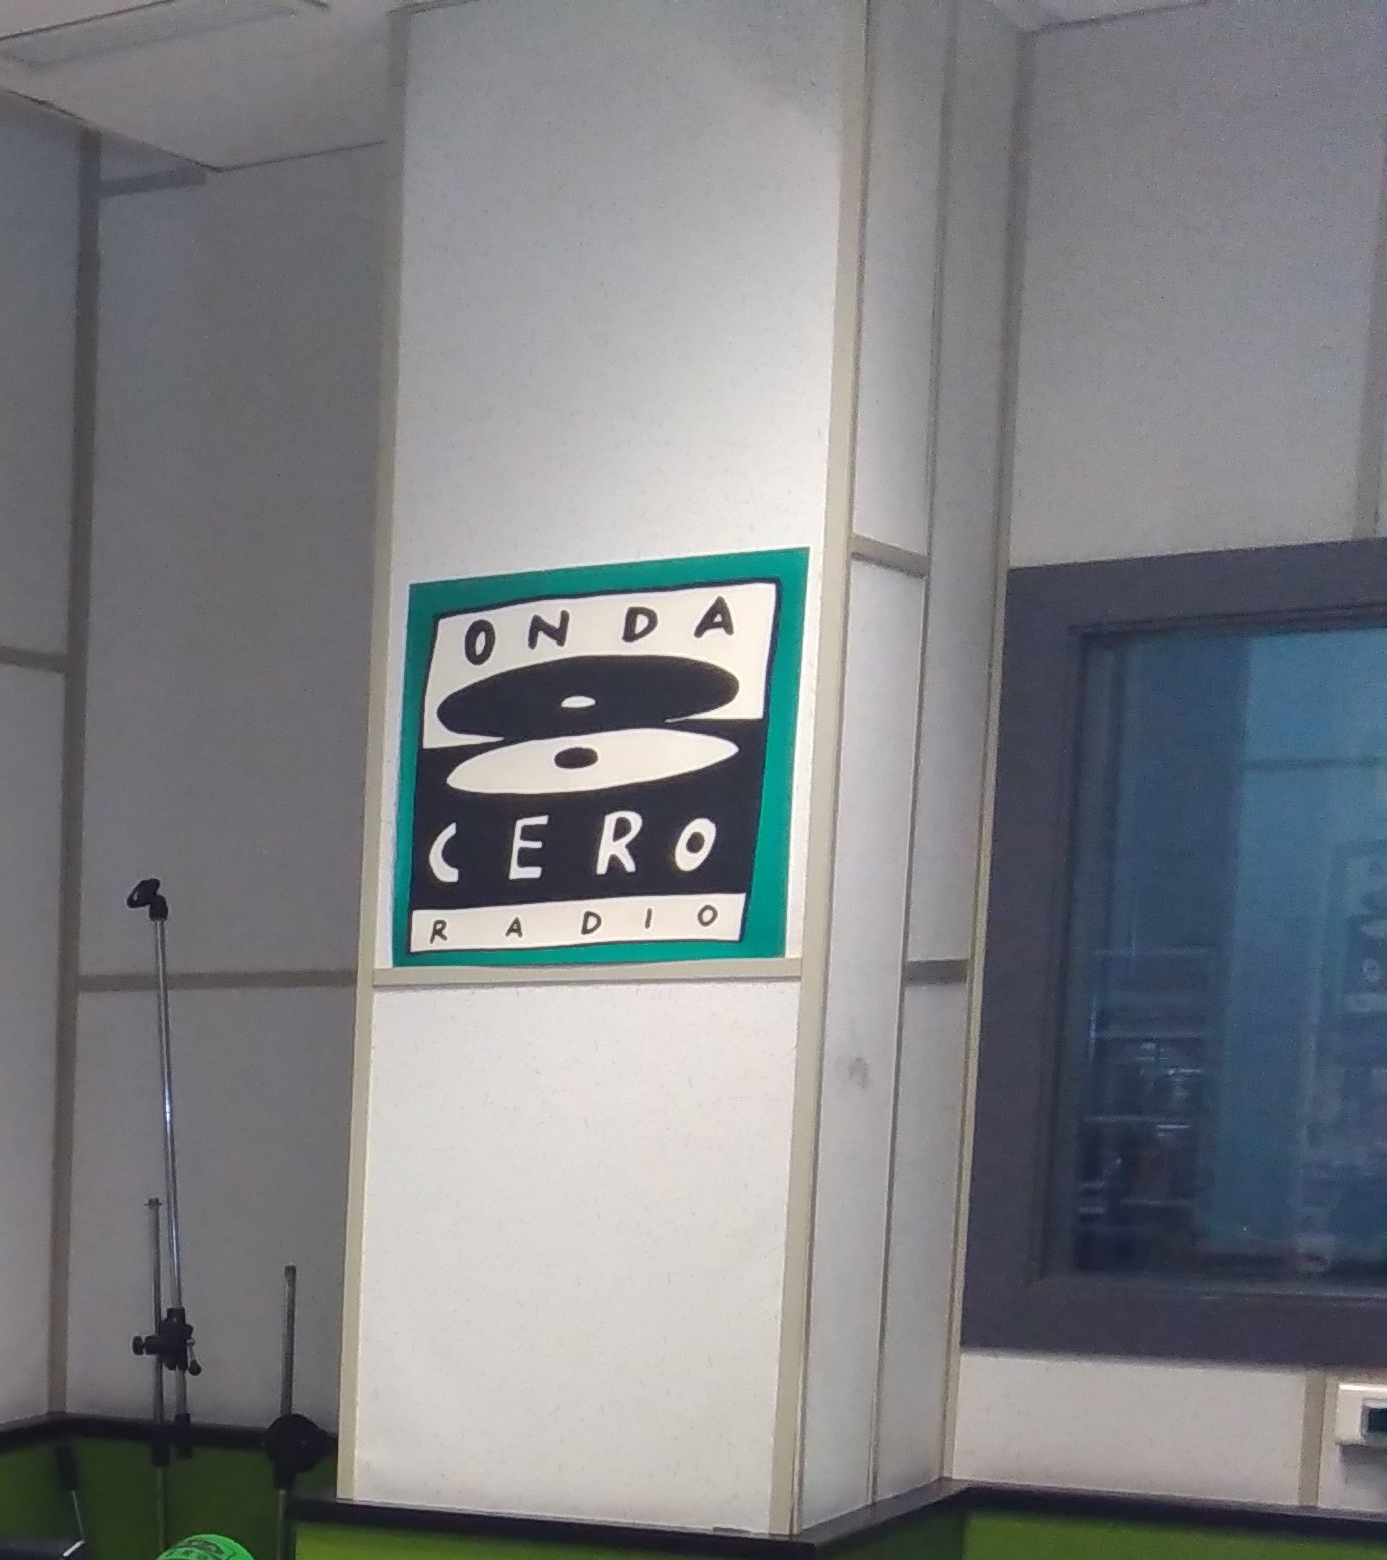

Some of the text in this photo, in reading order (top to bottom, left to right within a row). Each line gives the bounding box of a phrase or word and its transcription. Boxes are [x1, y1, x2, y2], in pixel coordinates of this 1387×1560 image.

[464, 596, 734, 665] ONDA
[429, 810, 717, 883] CERO
[429, 903, 719, 944] RADIO
